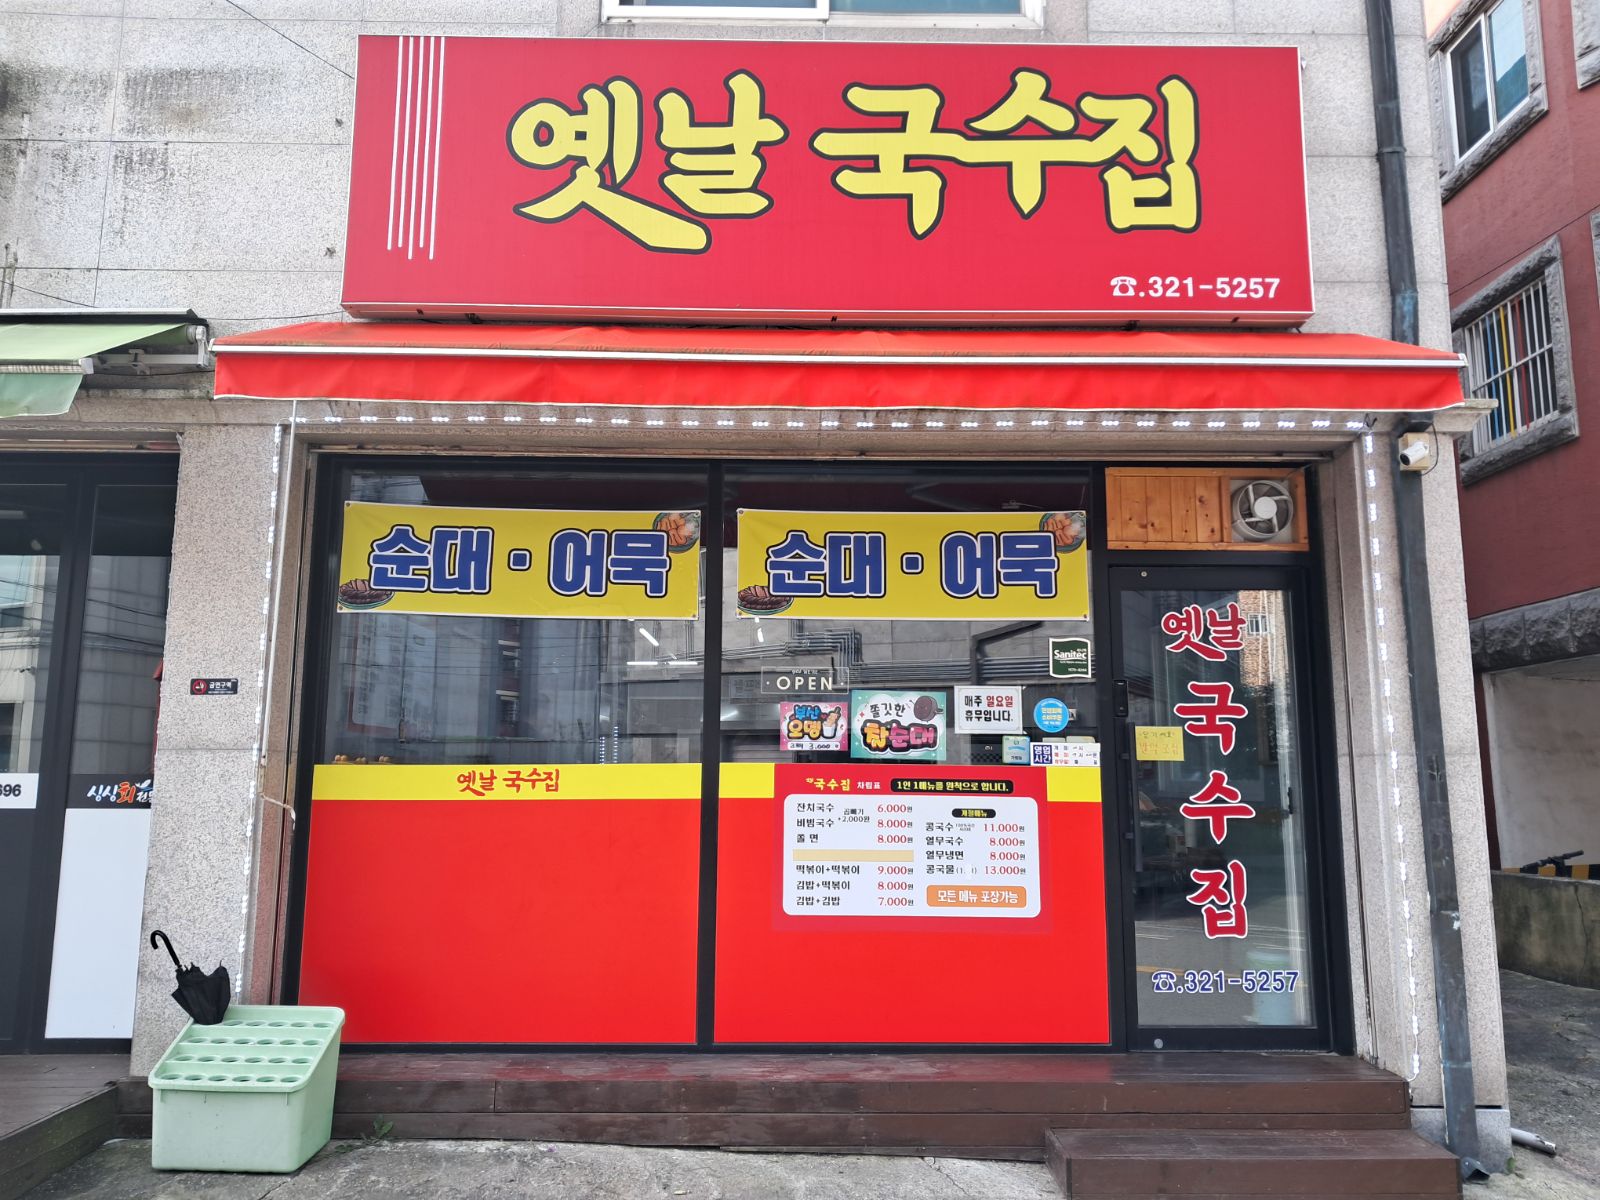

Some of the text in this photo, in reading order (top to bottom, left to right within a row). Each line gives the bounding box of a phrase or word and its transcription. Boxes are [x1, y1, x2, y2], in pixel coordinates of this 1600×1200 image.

[506, 67, 1201, 255] 옛날 국수집
[368, 524, 672, 597] 순대 어묵
[765, 529, 1059, 598] 순대 어묵
[1161, 602, 1246, 661] 옛날
[1054, 649, 1087, 660] Sanitec
[776, 676, 833, 690] OPEN
[964, 695, 1014, 708] 매주 일요일
[794, 705, 822, 721] 부산
[869, 702, 906, 718] 쫄깃한
[965, 710, 1014, 722] 휴무입니다.
[787, 720, 822, 739] 오뎅
[862, 720, 937, 750] 찰순대
[1034, 745, 1051, 755] 영업
[1034, 754, 1052, 763] 시간
[457, 768, 560, 797] 옛날 국수집
[814, 778, 851, 791] 국수집
[857, 781, 881, 790] 차림표
[897, 780, 1010, 792] 1인 1메뉴를 원칙으로 합니다.
[0, 783, 22, 798] 96
[796, 802, 835, 813] 잔치국수
[796, 818, 835, 828] 비빔국수
[926, 822, 954, 832] 콩국수
[926, 836, 964, 846] 열무국수
[926, 850, 964, 860] 열무냉면
[796, 864, 860, 875] 떡볶이+떡볶이
[926, 864, 955, 875] 콩국물
[796, 880, 851, 890] 김밥+떡볶이
[796, 896, 841, 906] 김밥+김밥
[938, 890, 1019, 904] 모든 메뉴 포장가능
